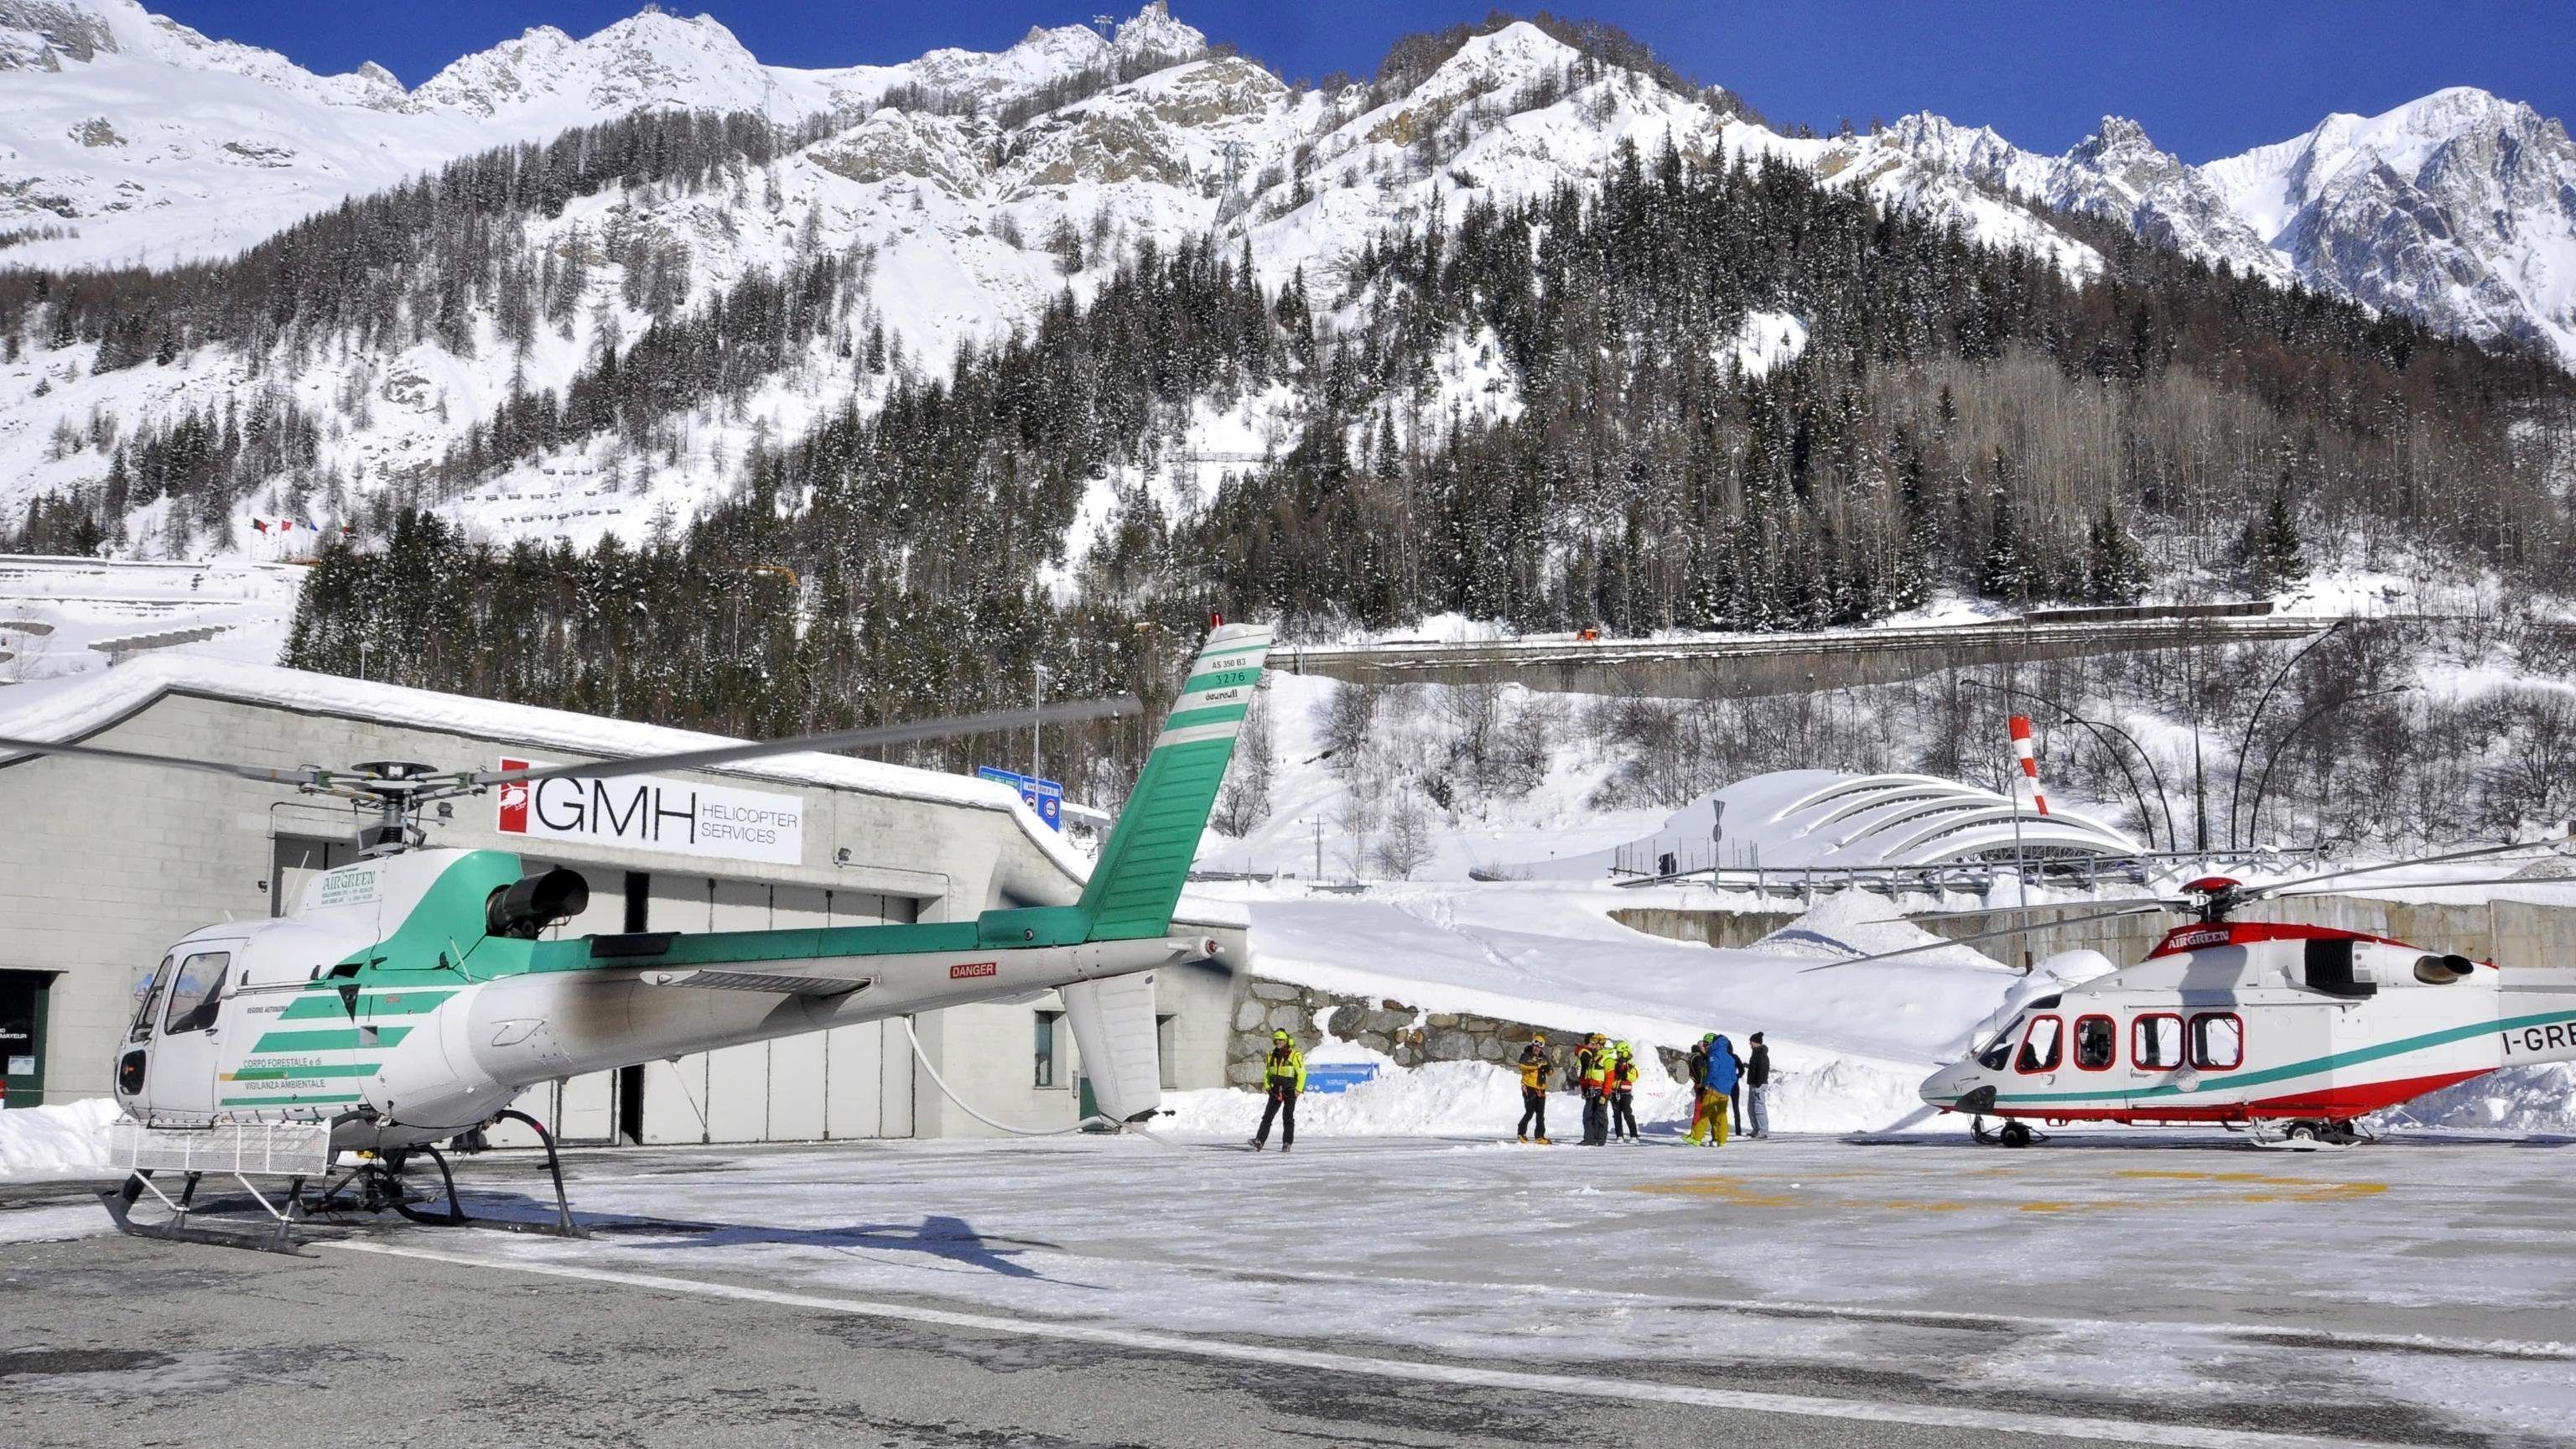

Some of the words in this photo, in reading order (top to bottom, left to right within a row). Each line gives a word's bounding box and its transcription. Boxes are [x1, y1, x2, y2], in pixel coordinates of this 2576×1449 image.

[1212, 661, 1222, 669] AS
[1223, 659, 1235, 668] 350
[1236, 657, 1246, 667] B3
[1215, 671, 1245, 685] 3276
[536, 777, 696, 844] GMH
[702, 802, 797, 828] HELICOPTER
[701, 822, 776, 845] SERVICES
[2168, 930, 2230, 949] AIRGREEN
[953, 963, 994, 978] DANGER
[243, 1058, 267, 1068] CORPO
[267, 1057, 307, 1067] FORESTALE
[309, 1058, 314, 1067] e
[315, 1057, 323, 1066] di
[245, 1081, 279, 1090] VIGILANZA
[281, 1079, 325, 1089] AMBIENTALE
